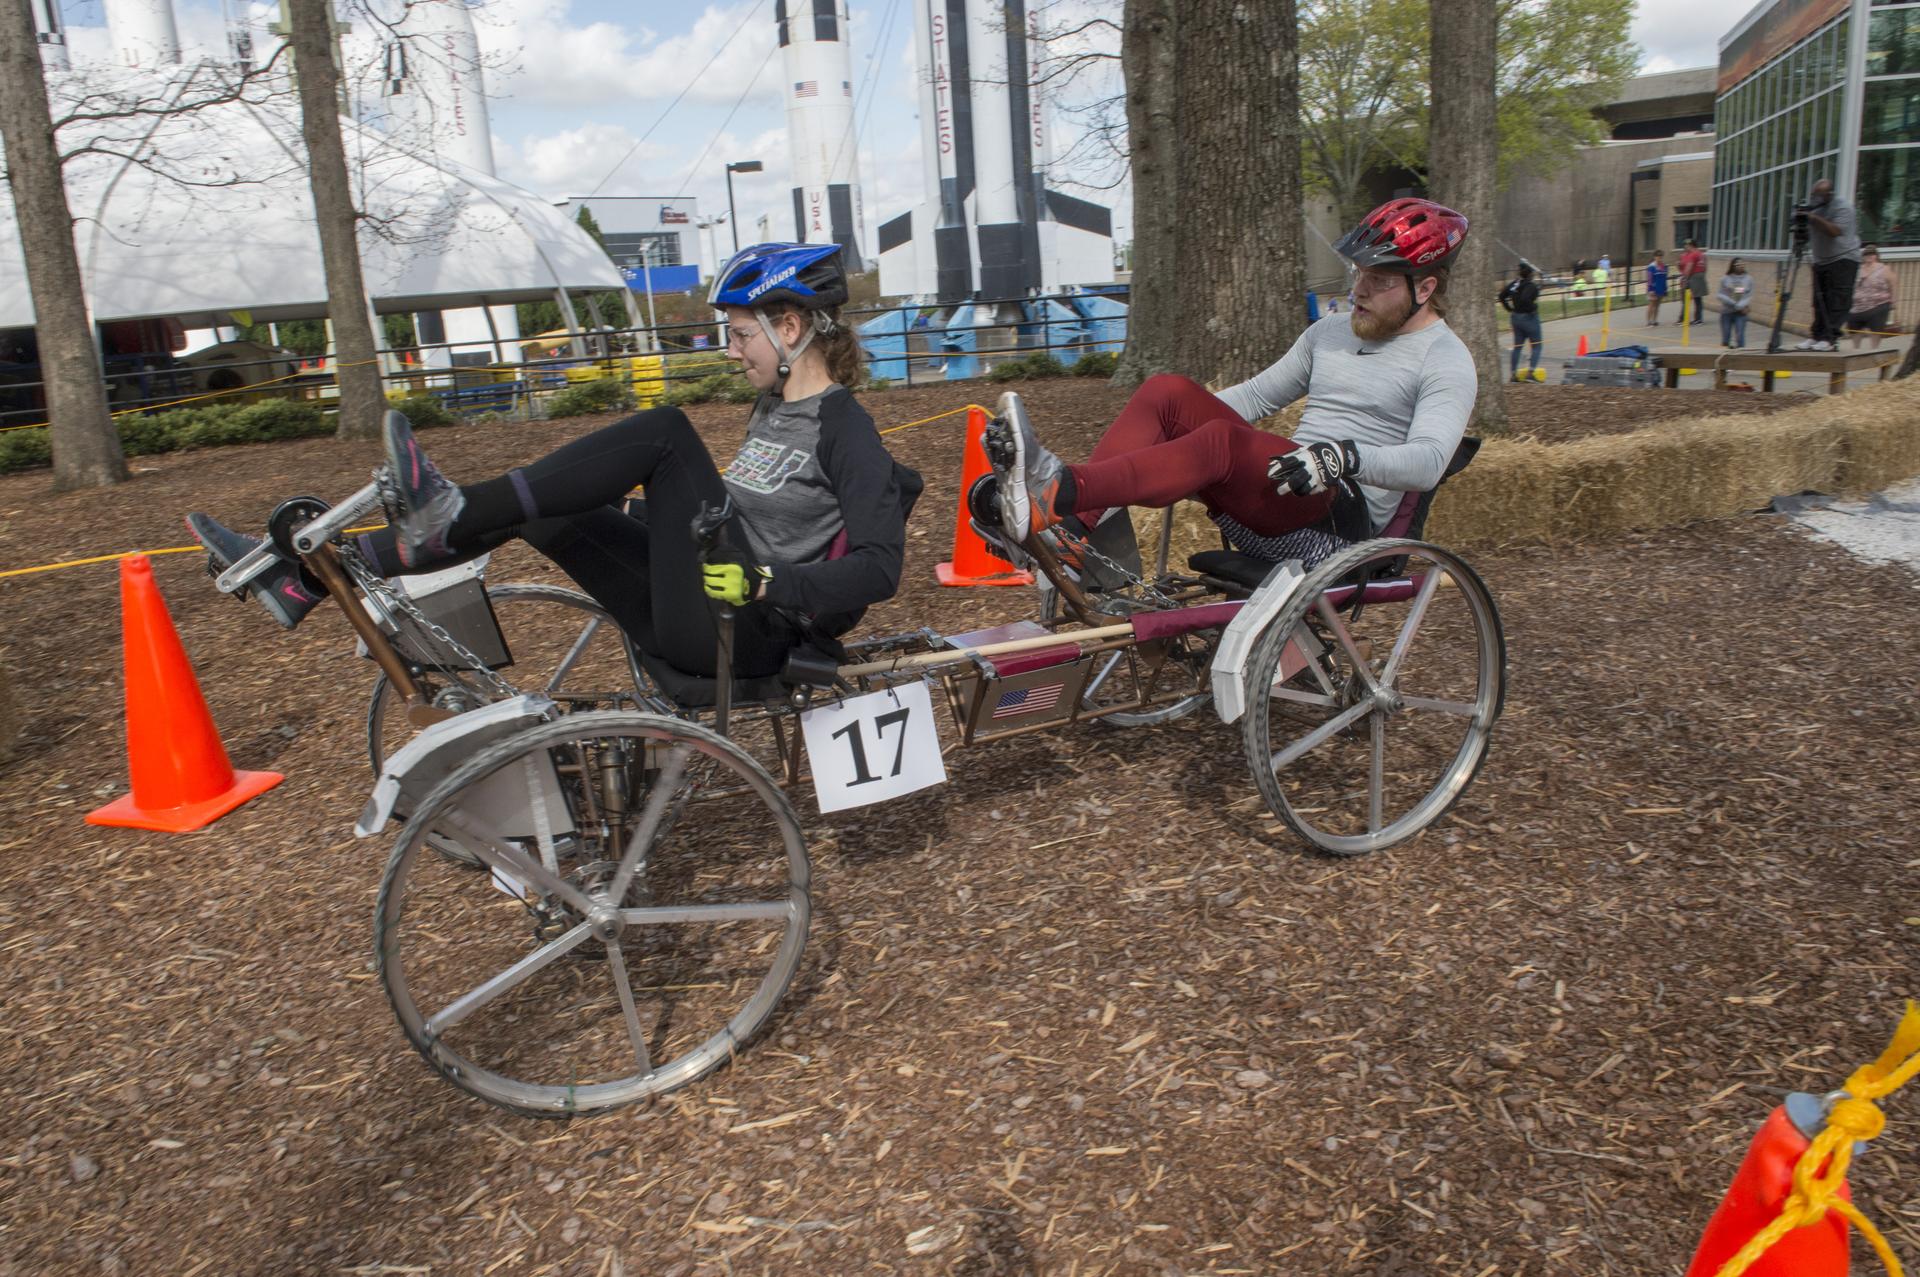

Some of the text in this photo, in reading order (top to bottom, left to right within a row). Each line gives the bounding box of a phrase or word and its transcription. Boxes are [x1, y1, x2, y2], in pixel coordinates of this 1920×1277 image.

[933, 14, 952, 154] STATES
[810, 191, 823, 231] USA
[831, 707, 910, 788] 17
